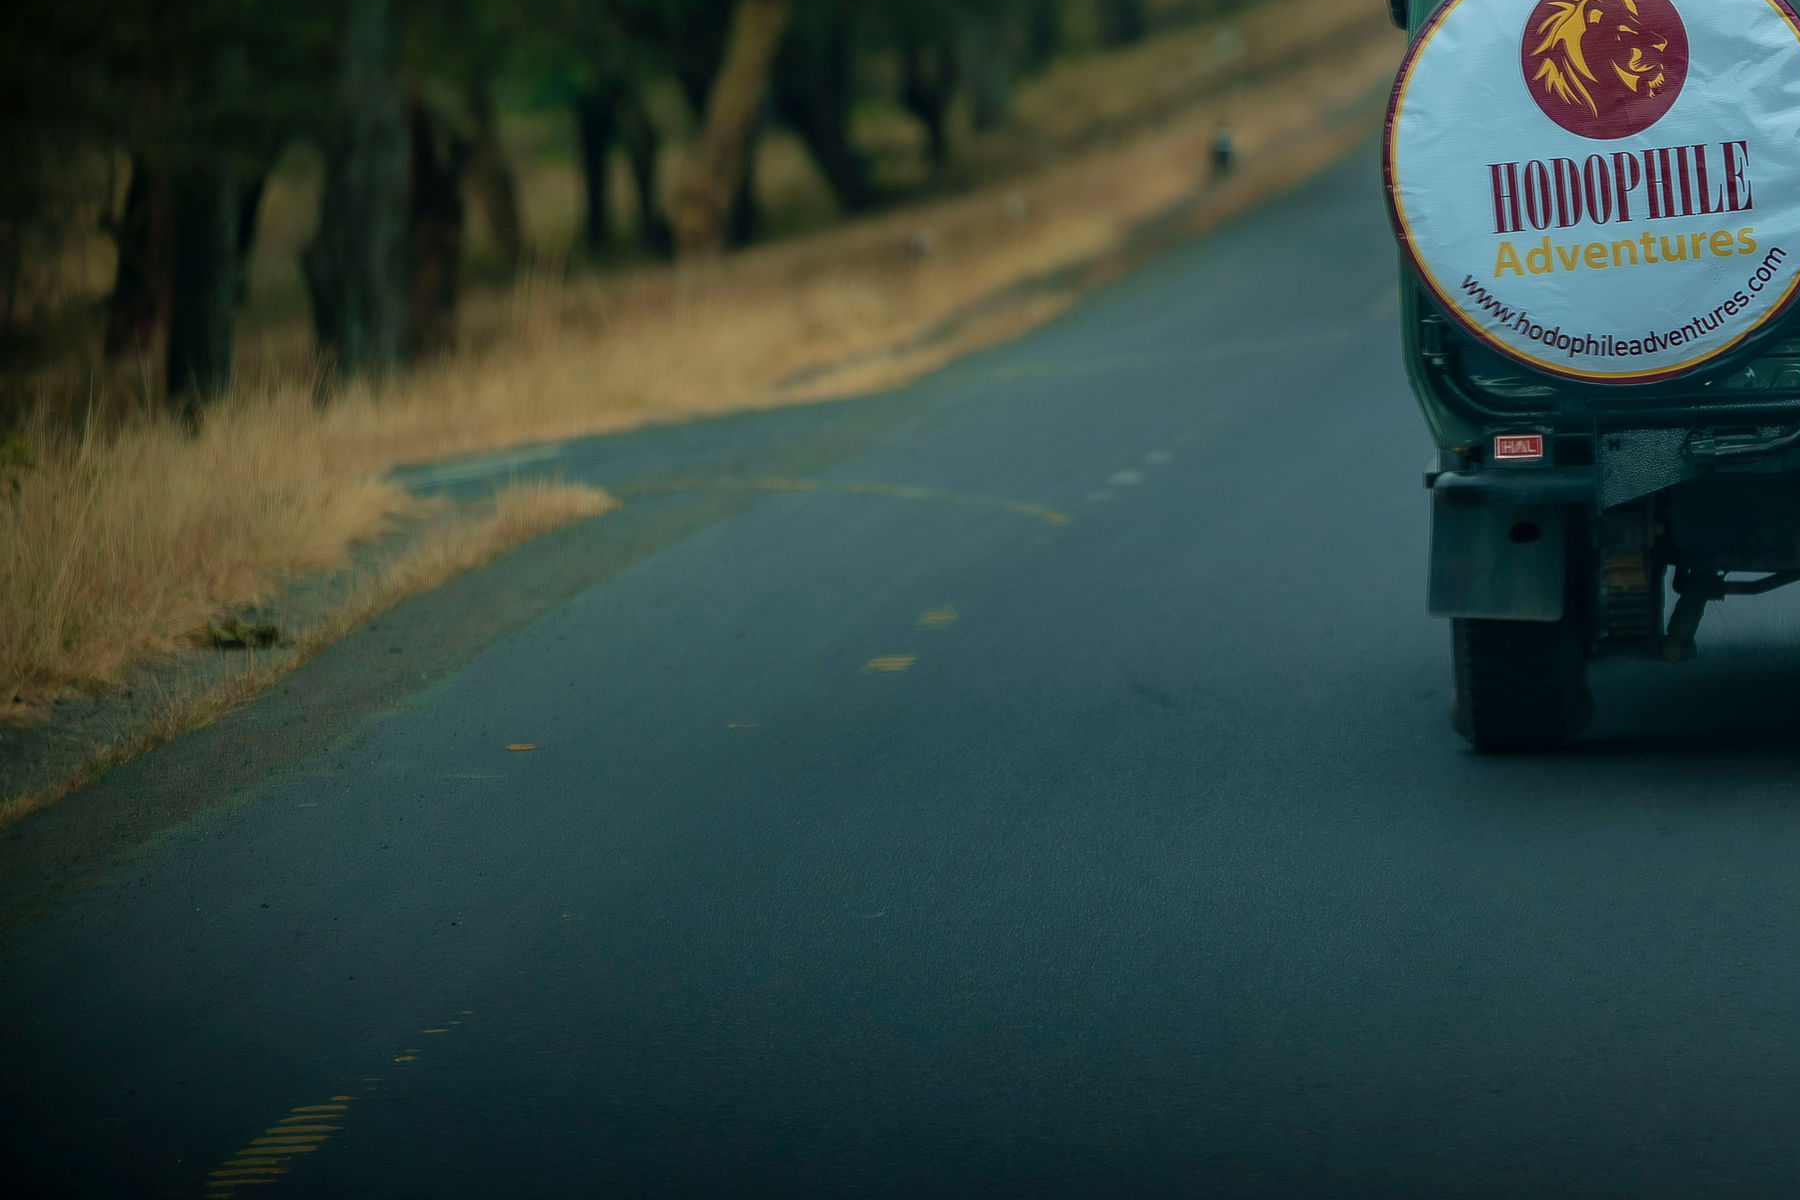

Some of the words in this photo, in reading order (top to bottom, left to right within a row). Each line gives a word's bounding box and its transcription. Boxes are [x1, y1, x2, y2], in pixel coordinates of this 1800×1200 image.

[1486, 140, 1753, 235] HODOPHILE
[1493, 227, 1758, 279] Adventures
[1460, 246, 1787, 358] www.hodophileadventures.com
[1500, 440, 1537, 454] HAL
